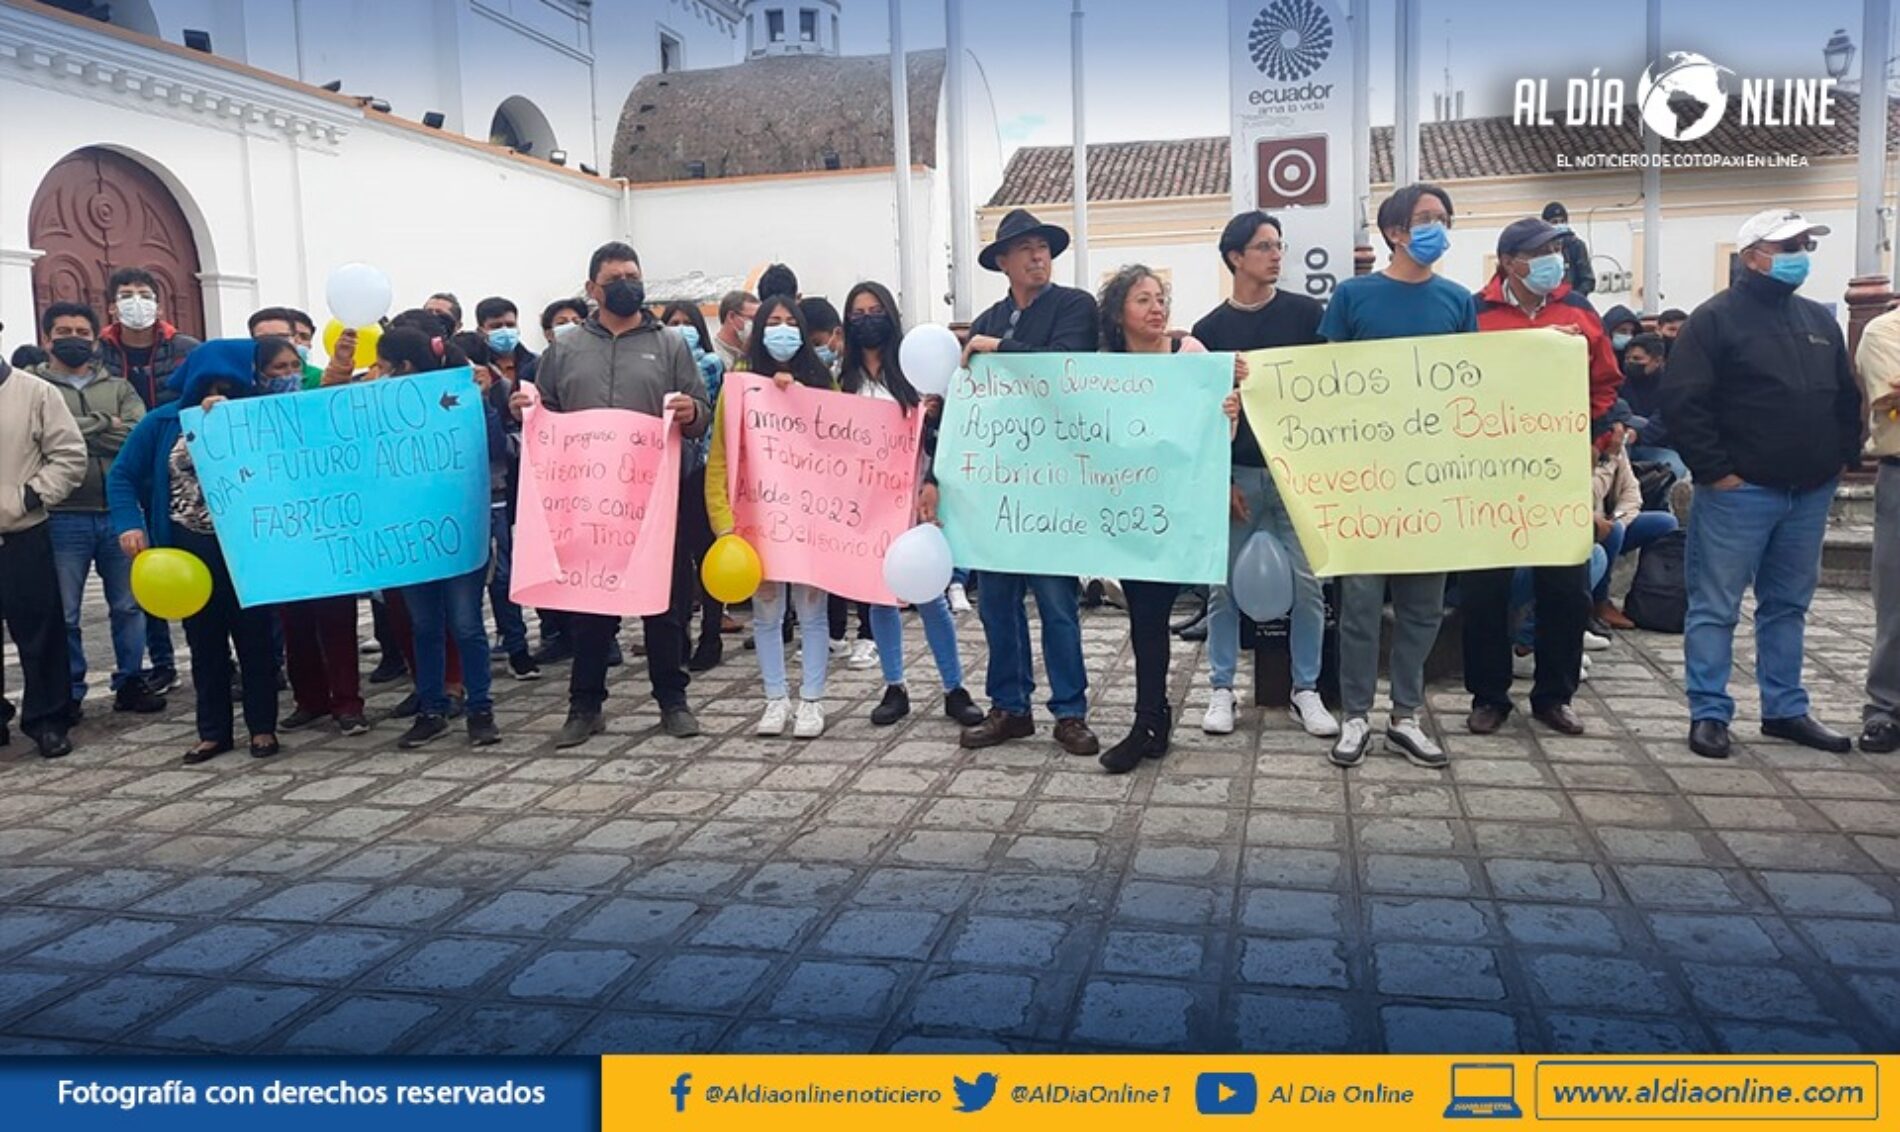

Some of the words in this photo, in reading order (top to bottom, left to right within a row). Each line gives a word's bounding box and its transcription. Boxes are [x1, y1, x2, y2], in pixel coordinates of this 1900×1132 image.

[1249, 82, 1334, 105] ecuador
[1304, 246, 1337, 304] go
[956, 365, 1050, 400] Belisario
[1061, 357, 1155, 395] Quevedo
[1263, 359, 1391, 402] Todos
[1412, 345, 1482, 392] los
[201, 395, 303, 461] CHAN
[330, 378, 427, 442] CHICO
[538, 423, 556, 446] el
[815, 404, 872, 446] todos
[961, 402, 1047, 452] Apoyo
[1054, 407, 1112, 444] total
[1128, 417, 1150, 438] a
[1278, 415, 1396, 452] Barrios
[1403, 407, 1443, 437] de
[1446, 395, 1589, 440] Belisario
[267, 444, 361, 482] FUTURO
[760, 434, 848, 478] Fabricio
[960, 453, 1069, 486] Fabricio
[252, 491, 363, 539] FABRICIO
[800, 489, 862, 528] 2023
[994, 495, 1088, 535] Alcalde
[1100, 504, 1170, 537] 2023
[1313, 502, 1442, 541] Fabricio
[1442, 493, 1591, 551] Tinajero
[314, 515, 462, 576] TINAJERO
